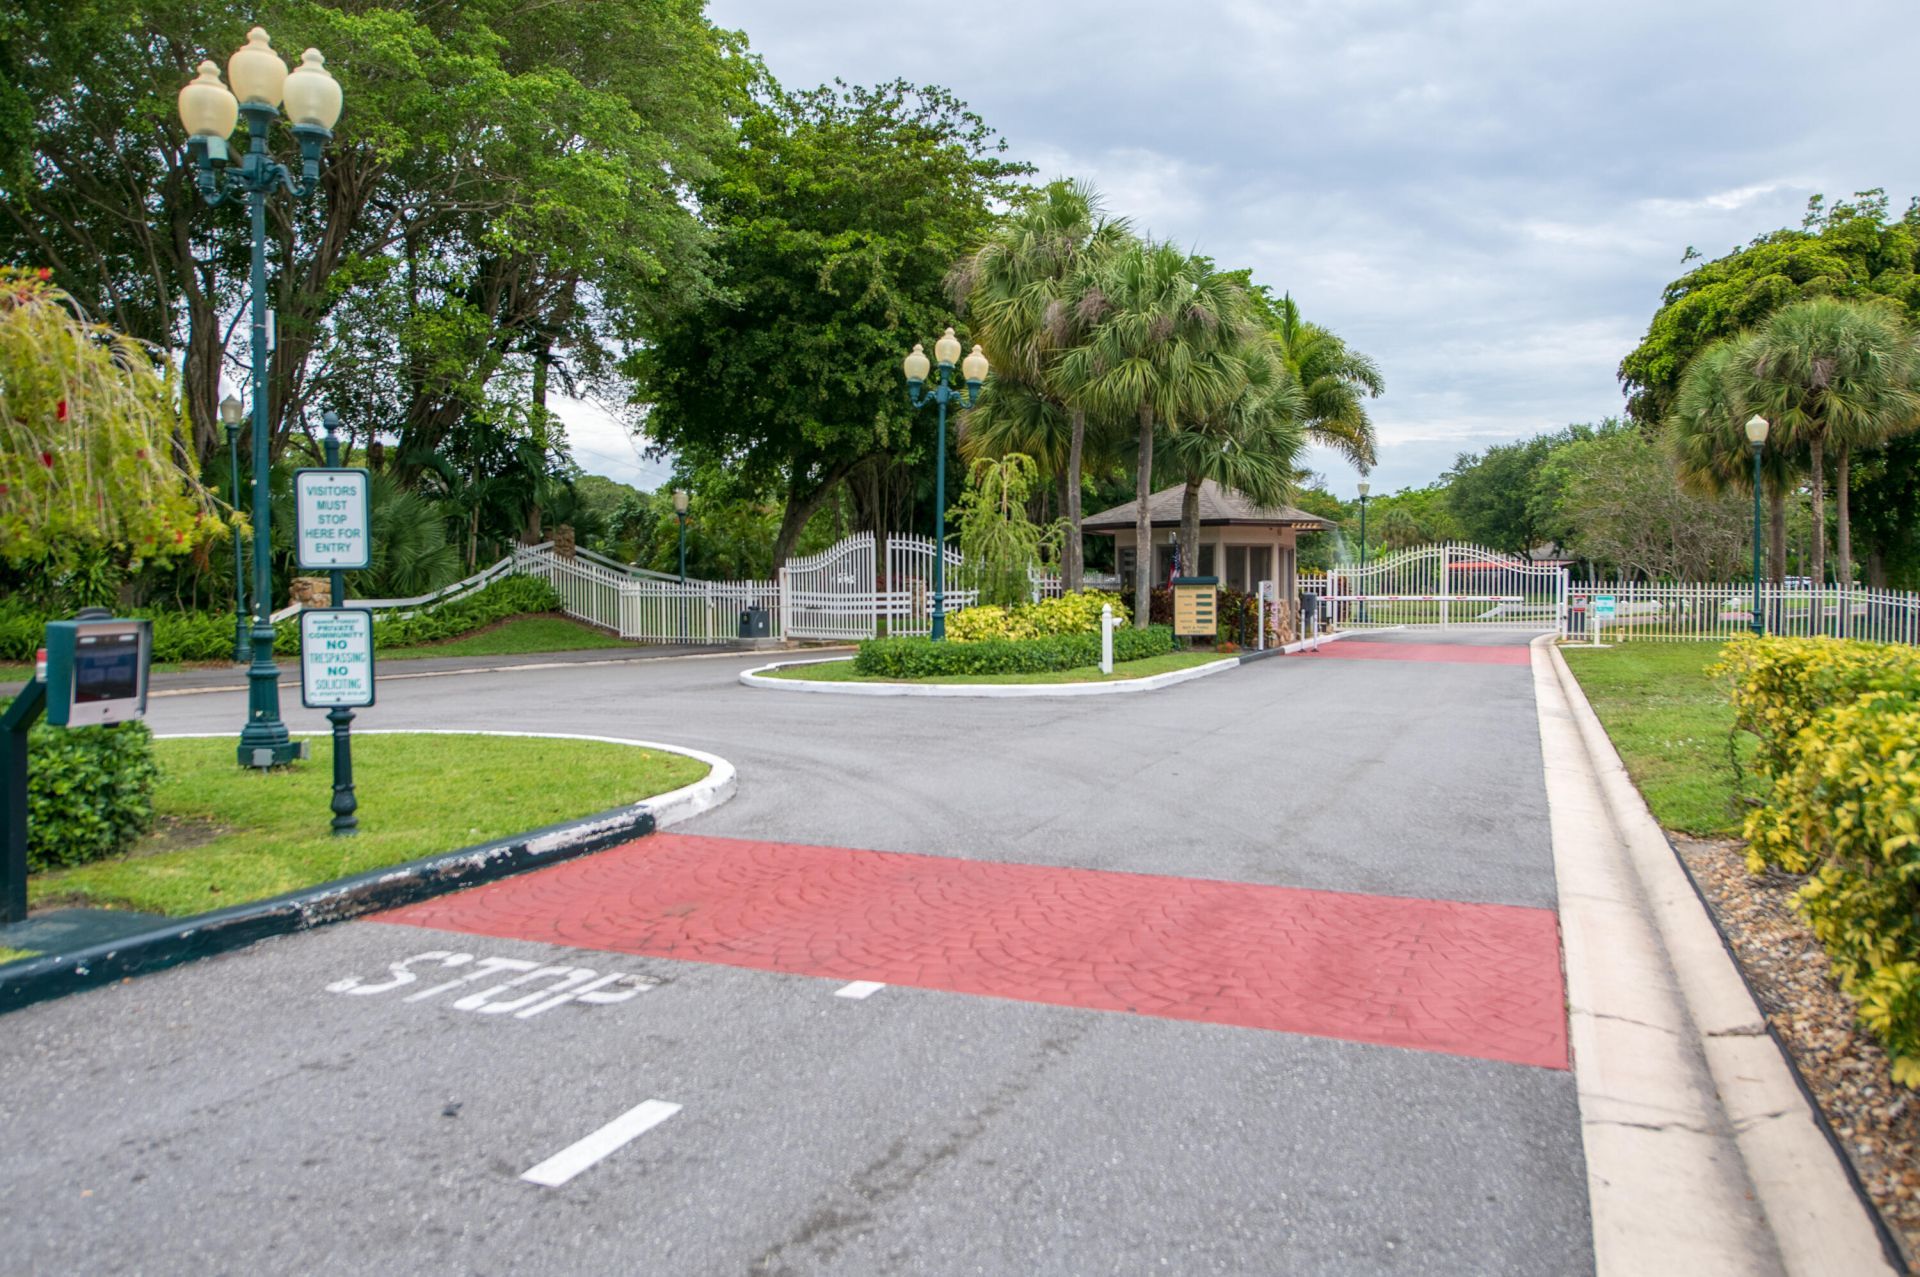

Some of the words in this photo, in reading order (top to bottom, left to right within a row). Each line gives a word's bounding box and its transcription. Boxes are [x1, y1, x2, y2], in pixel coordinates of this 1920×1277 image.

[306, 486, 357, 496] VISITORS
[317, 500, 347, 510] MUST
[318, 514, 347, 524] STOP
[305, 528, 335, 538] HERE
[338, 528, 361, 538] FOR
[315, 543, 351, 553] ENTRY
[326, 639, 347, 649] NO
[309, 652, 366, 663] TRESPASSING
[327, 666, 348, 676] NO
[315, 679, 361, 690] SOLICITING
[325, 950, 654, 1019] STOP
